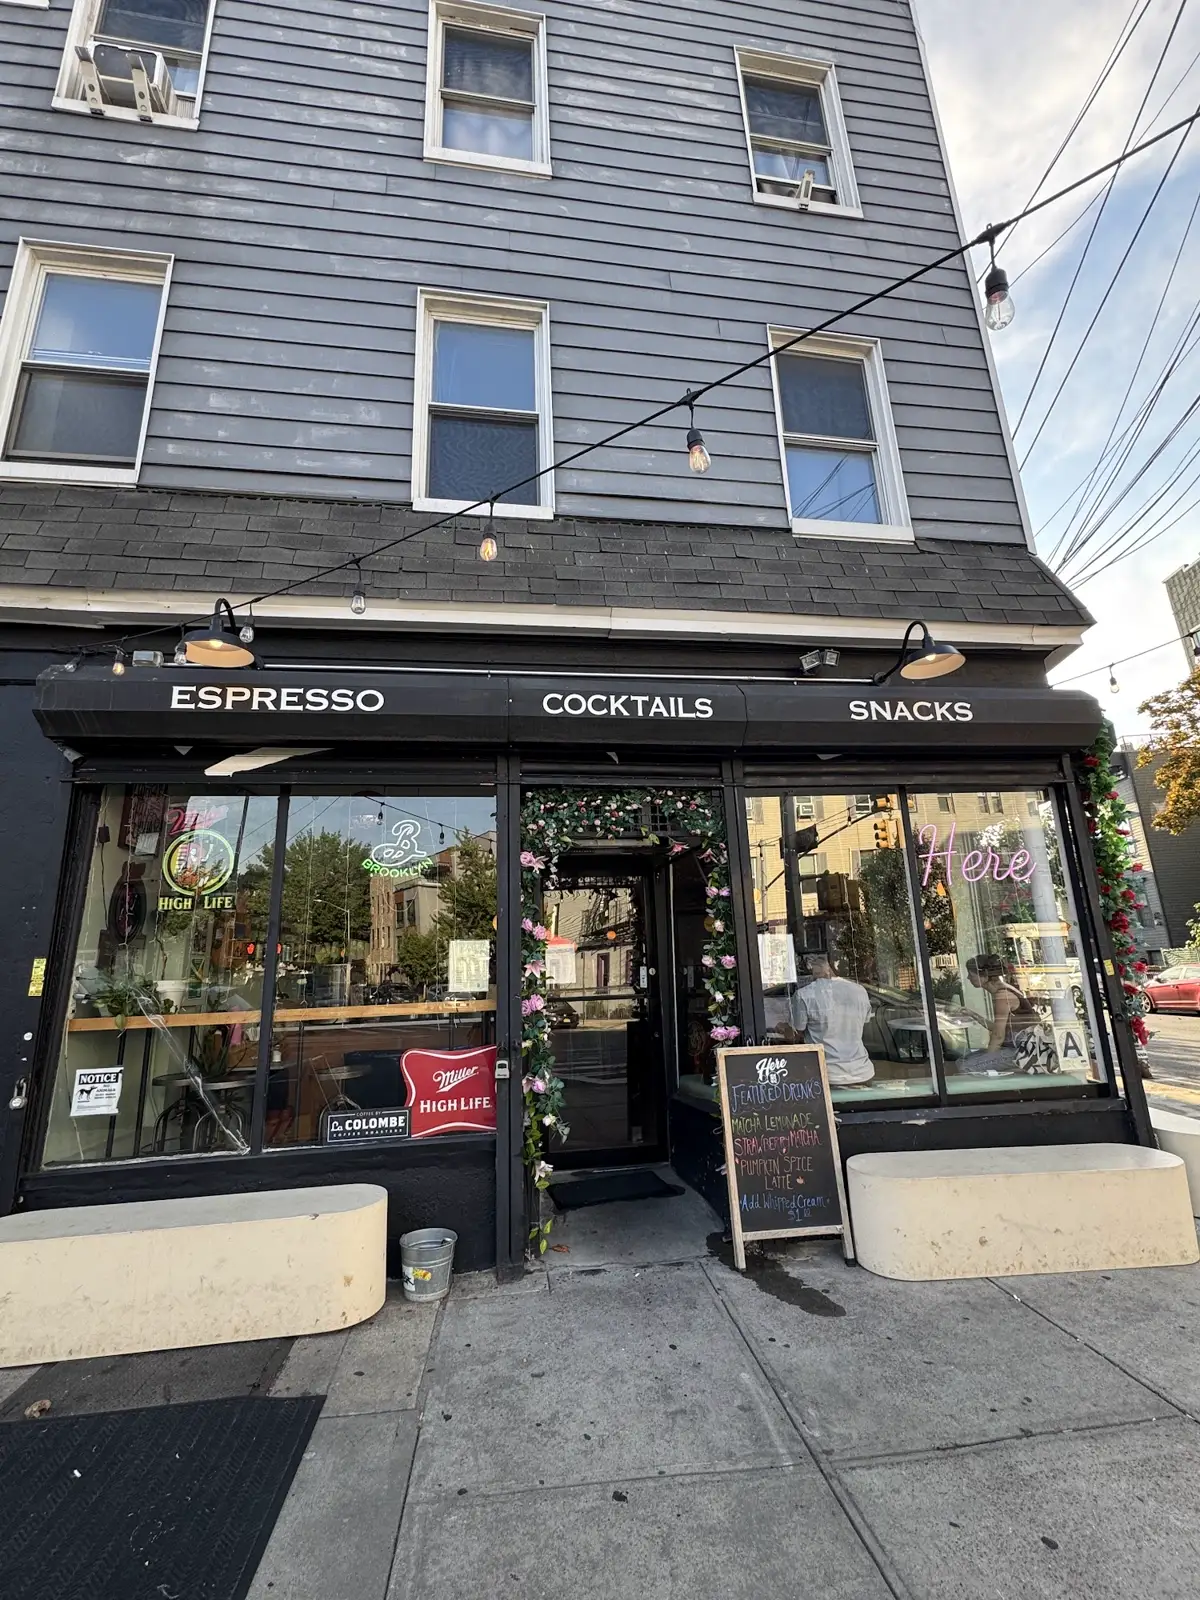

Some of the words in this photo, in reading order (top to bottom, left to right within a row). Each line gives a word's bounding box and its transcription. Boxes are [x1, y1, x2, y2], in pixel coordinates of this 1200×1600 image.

[170, 685, 385, 712] ESPRESSO
[542, 693, 713, 719] COCKTAILS
[848, 700, 974, 722] SNACKS
[918, 822, 1037, 887] Here
[361, 857, 434, 878] BROOKLYN
[158, 897, 193, 910] HIGH
[203, 896, 233, 909] LIFE
[1063, 1031, 1083, 1058] A
[80, 1073, 117, 1084] NOTICE
[432, 1066, 480, 1094] Miller
[755, 1057, 789, 1084] Here
[782, 1081, 822, 1102] DRINKS
[419, 1100, 457, 1114] HIGH
[460, 1097, 491, 1111] LIFE
[330, 1121, 344, 1132] La
[345, 1116, 406, 1131] COLOMBE
[731, 1114, 761, 1134] MATCHA
[764, 1112, 814, 1131] LEMONADE
[789, 1129, 821, 1148] MATCHA
[740, 1158, 780, 1176] PUMPKIN
[783, 1156, 813, 1173] SPICE
[765, 1174, 793, 1190] LATTE
[741, 1194, 760, 1211] Add
[763, 1193, 796, 1212] Whipped
[797, 1194, 825, 1208] Cream
